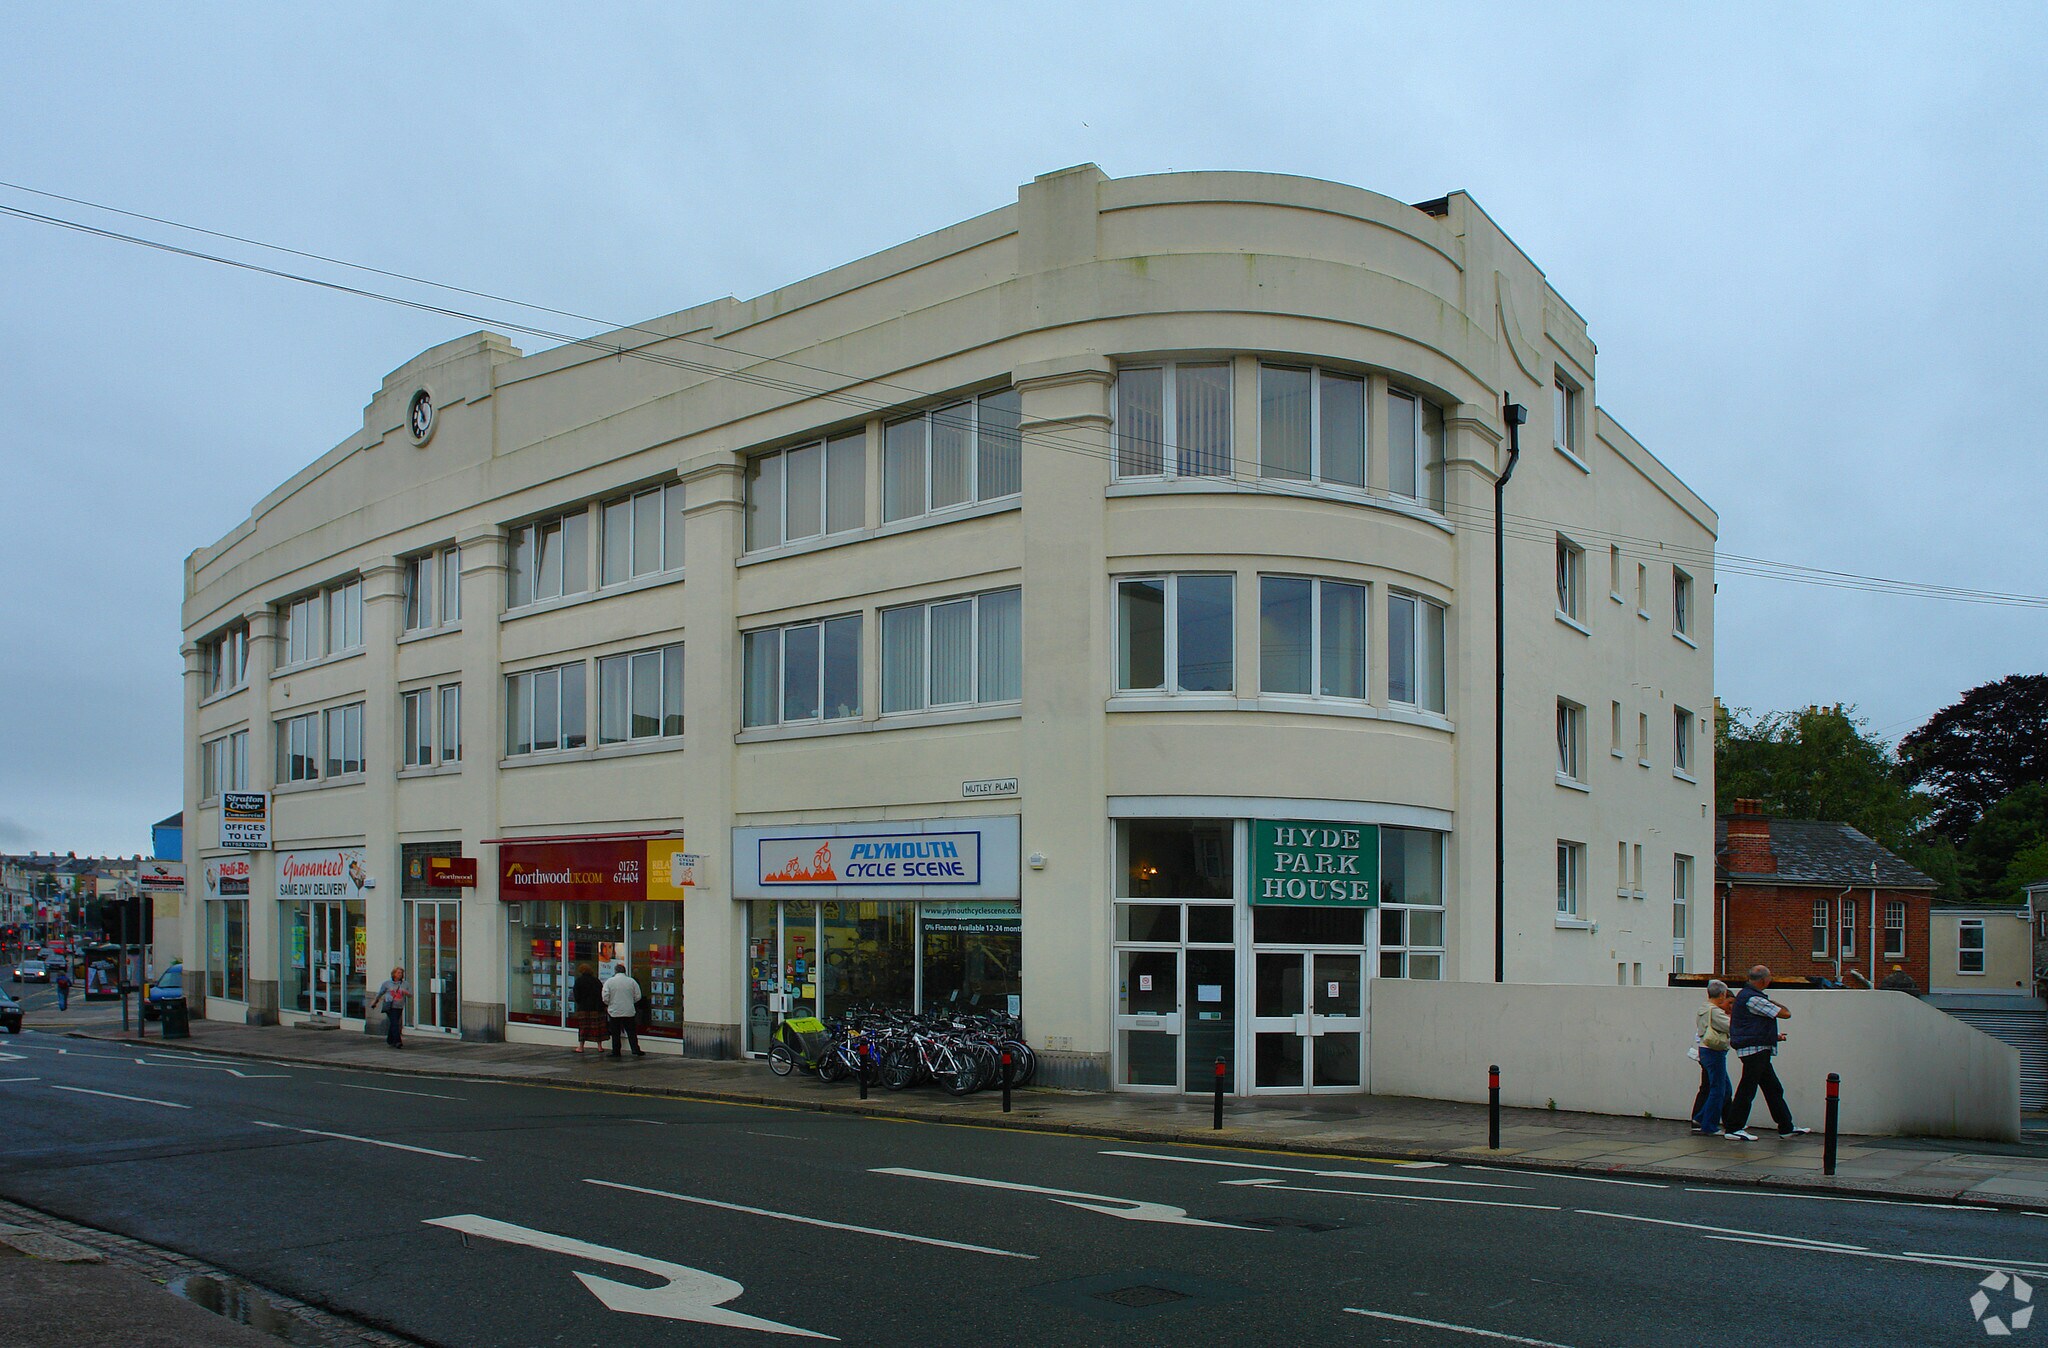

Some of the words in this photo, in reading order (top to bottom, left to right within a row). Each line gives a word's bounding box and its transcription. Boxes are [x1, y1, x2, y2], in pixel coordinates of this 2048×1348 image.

[965, 783, 991, 793] MUTLEY
[995, 782, 1015, 791] PLAIN
[226, 794, 264, 803] Stratton
[230, 801, 260, 810] Creber
[225, 823, 266, 832] OFFICES
[228, 832, 241, 840] TO
[1273, 827, 1360, 849] HYDE
[850, 841, 959, 860] PLYMOUTH
[283, 852, 344, 884] Guaranteed
[618, 860, 639, 872] 01752
[652, 860, 672, 870] RELA
[845, 862, 896, 878] CYCLE
[903, 861, 965, 877] SCENE
[1273, 852, 1360, 875] PARK
[514, 867, 603, 885] northwoodUK.COM
[613, 871, 639, 884] 674404
[280, 883, 298, 896] SAME
[299, 883, 313, 896] DAY
[314, 883, 348, 896] DELIVERY
[1262, 877, 1369, 901] HOUSE
[958, 924, 985, 932] Available
